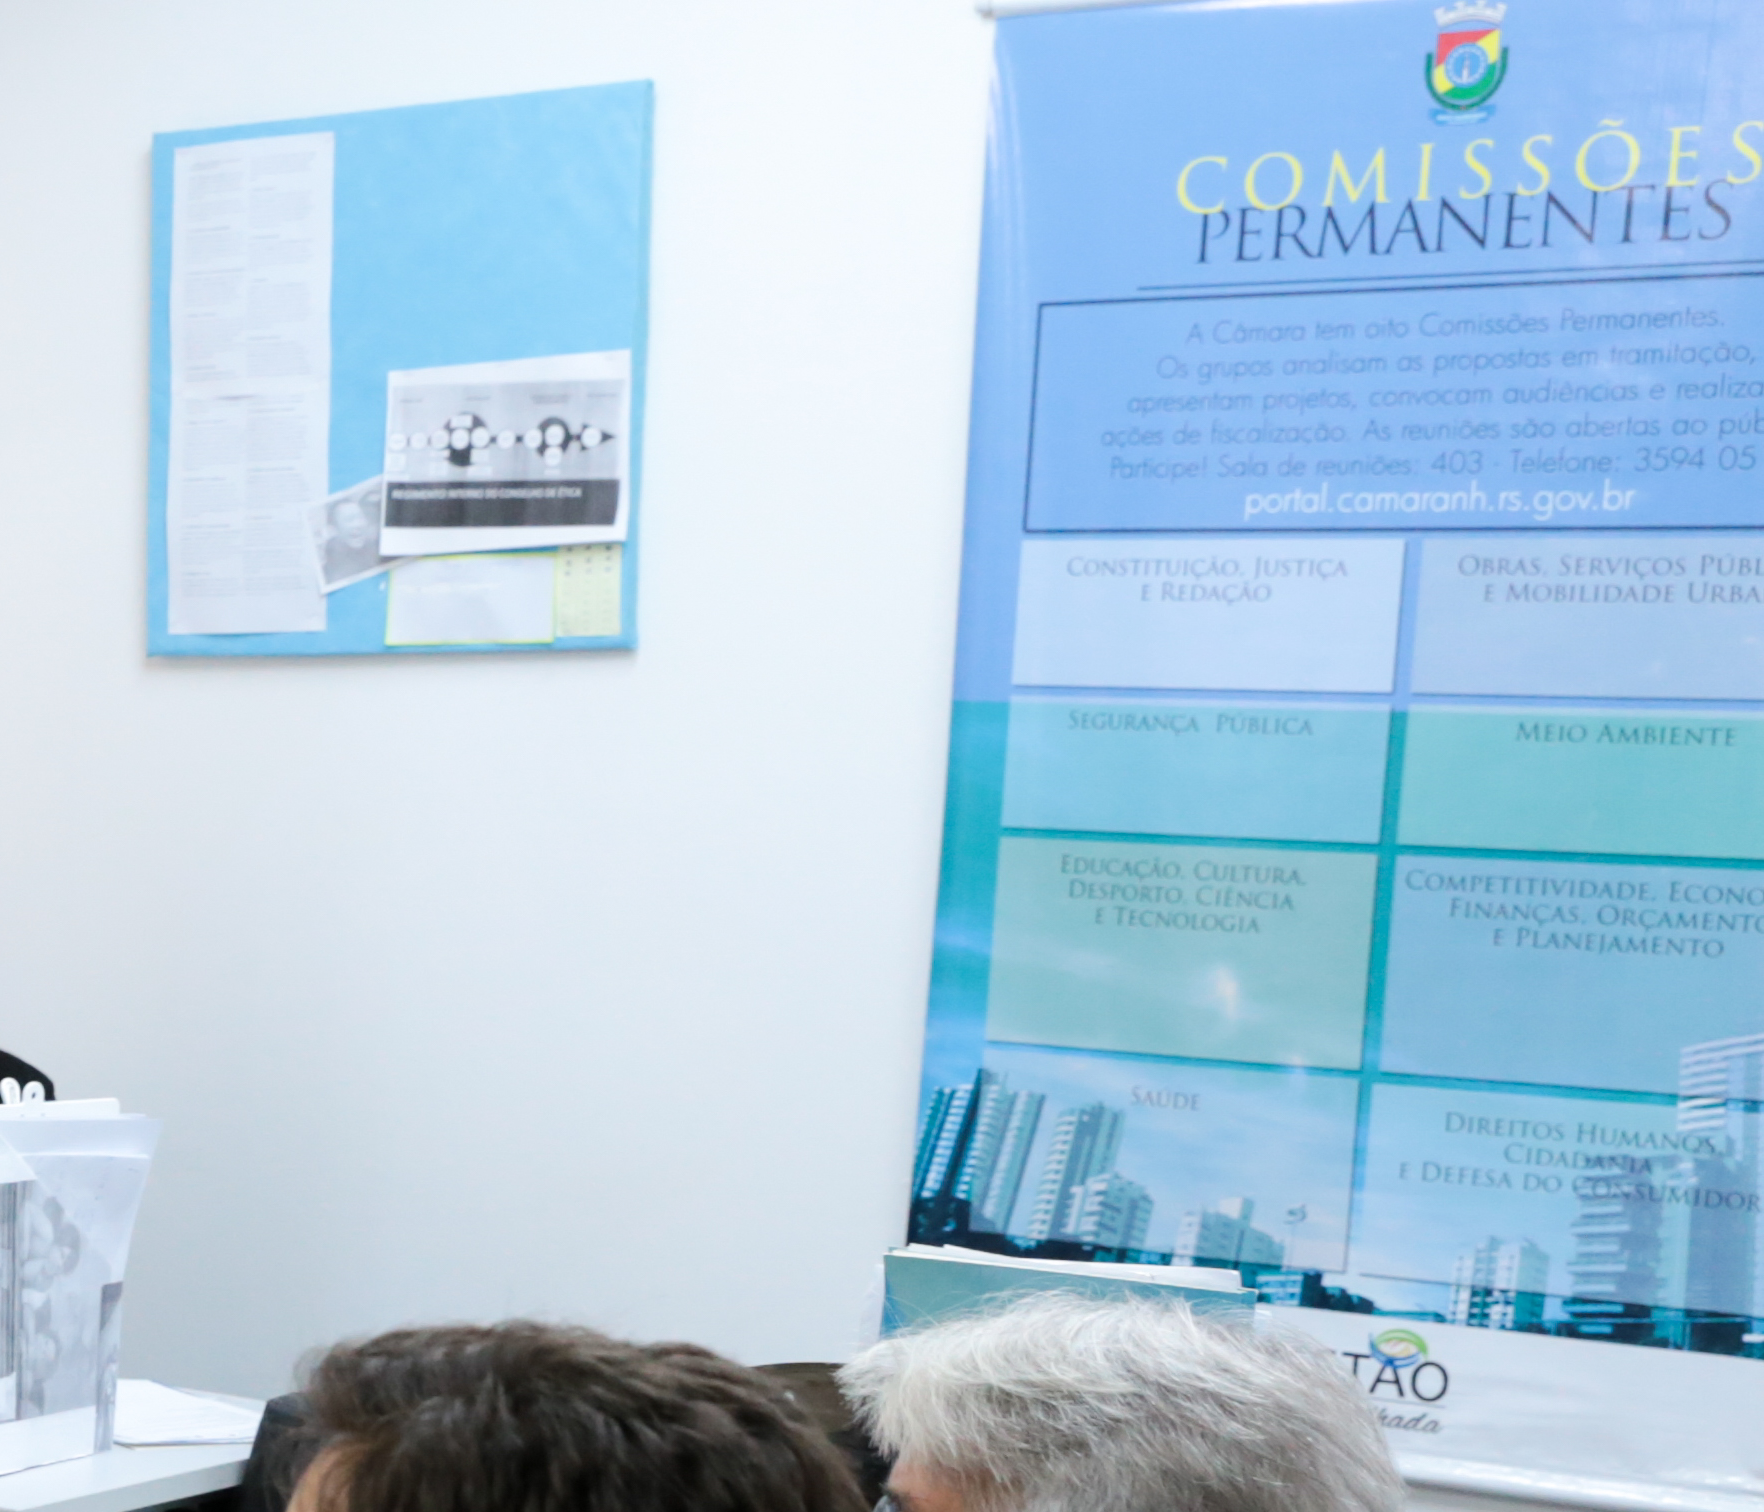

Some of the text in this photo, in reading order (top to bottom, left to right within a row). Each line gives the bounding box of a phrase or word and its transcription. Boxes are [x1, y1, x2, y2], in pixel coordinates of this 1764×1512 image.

[1176, 119, 1764, 215] COMISSÕES
[1198, 178, 1735, 264] PERMANENTES
[1186, 306, 1725, 344] A Câmara tem oito Comissões Permanentes.
[1156, 355, 1188, 379] Os
[1197, 360, 1274, 385] grupos
[1282, 350, 1387, 376] analisam
[1397, 354, 1423, 373] as
[1433, 349, 1552, 376] propostas
[1561, 350, 1598, 367] em
[1127, 395, 1252, 417] apresentam
[1368, 387, 1492, 407] convocam
[1502, 377, 1638, 404] audiências
[1648, 381, 1666, 400] e
[1101, 424, 1163, 448] ações
[1172, 420, 1202, 445] de
[1361, 419, 1392, 442] As
[1401, 419, 1500, 442] reuniões
[1509, 418, 1556, 438] são
[1565, 411, 1660, 438] abertas
[1672, 416, 1708, 436] ao
[1216, 453, 1268, 478] Sala
[1277, 453, 1306, 477] de
[1431, 449, 1483, 475] 403
[1634, 446, 1705, 472] 3594
[1243, 479, 1635, 521] portal.camaranh.rs.gov.br
[1253, 555, 1348, 580] JUSTIÇA
[1557, 554, 1687, 580] SERVIÇOS
[1160, 580, 1272, 605] REDAÇÃO
[1505, 581, 1675, 603] MOBILIDADE
[1687, 581, 1764, 603] URBA
[1067, 709, 1313, 736] SEGURANÇA PÚBLICA
[1515, 721, 1738, 747] MEIO AMBIENTE
[1195, 884, 1295, 911] CIÊNCIA
[1113, 905, 1261, 935] TECNOLOGIA
[1516, 926, 1724, 959] PLANEJAMENTO
[1444, 1111, 1565, 1143] DIREITOS
[1503, 1143, 1652, 1175] CIDADANIA
[1421, 1161, 1513, 1191] DEFESA
[1523, 1174, 1563, 1193] DO
[1572, 1175, 1761, 1213] CONSUMIDOR
